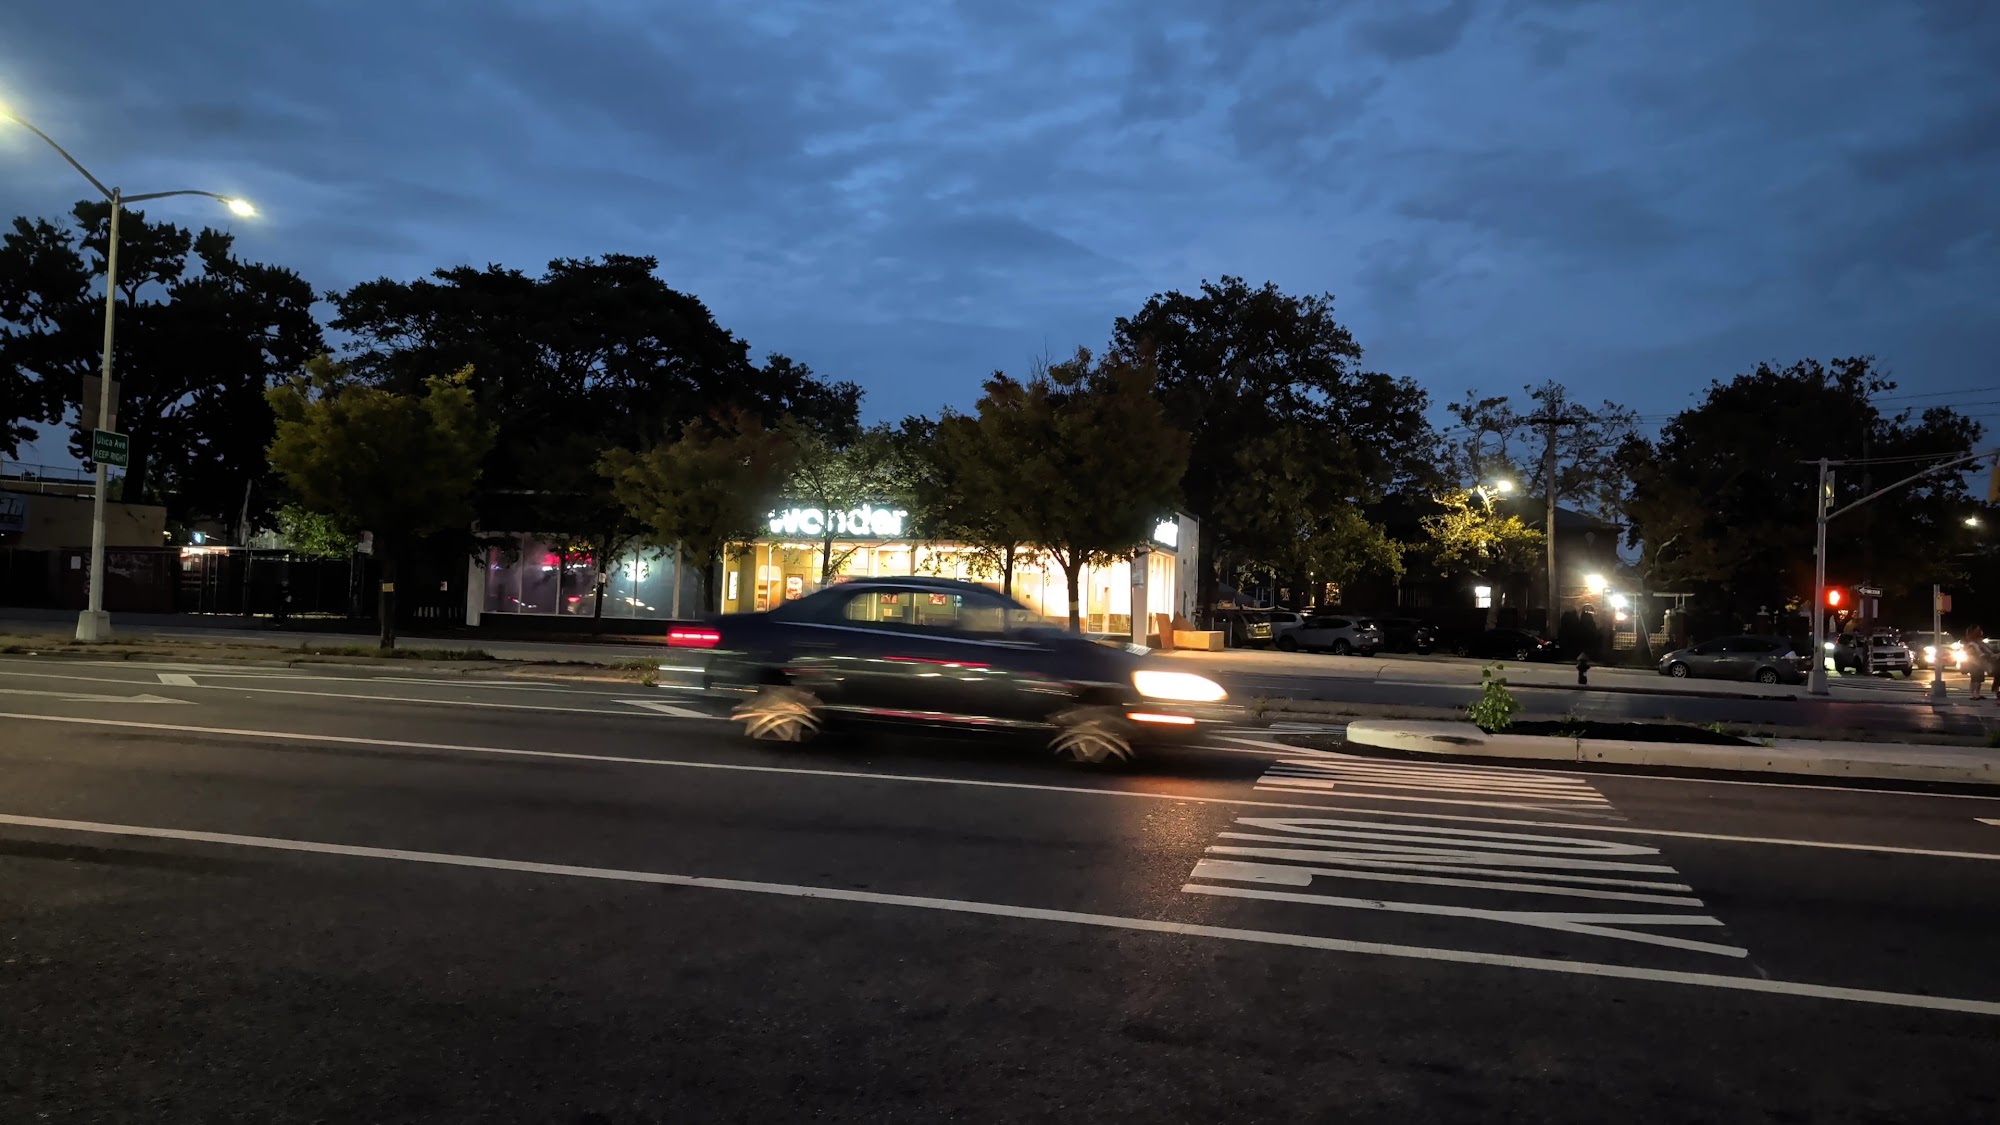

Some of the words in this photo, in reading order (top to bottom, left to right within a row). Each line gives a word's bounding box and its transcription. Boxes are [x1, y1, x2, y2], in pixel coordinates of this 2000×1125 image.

[114, 439, 126, 449] Ave
[94, 450, 109, 458] KEEP
[110, 452, 126, 462] RIGHT
[767, 503, 909, 535] wonder
[1180, 816, 1749, 959] ONLY
